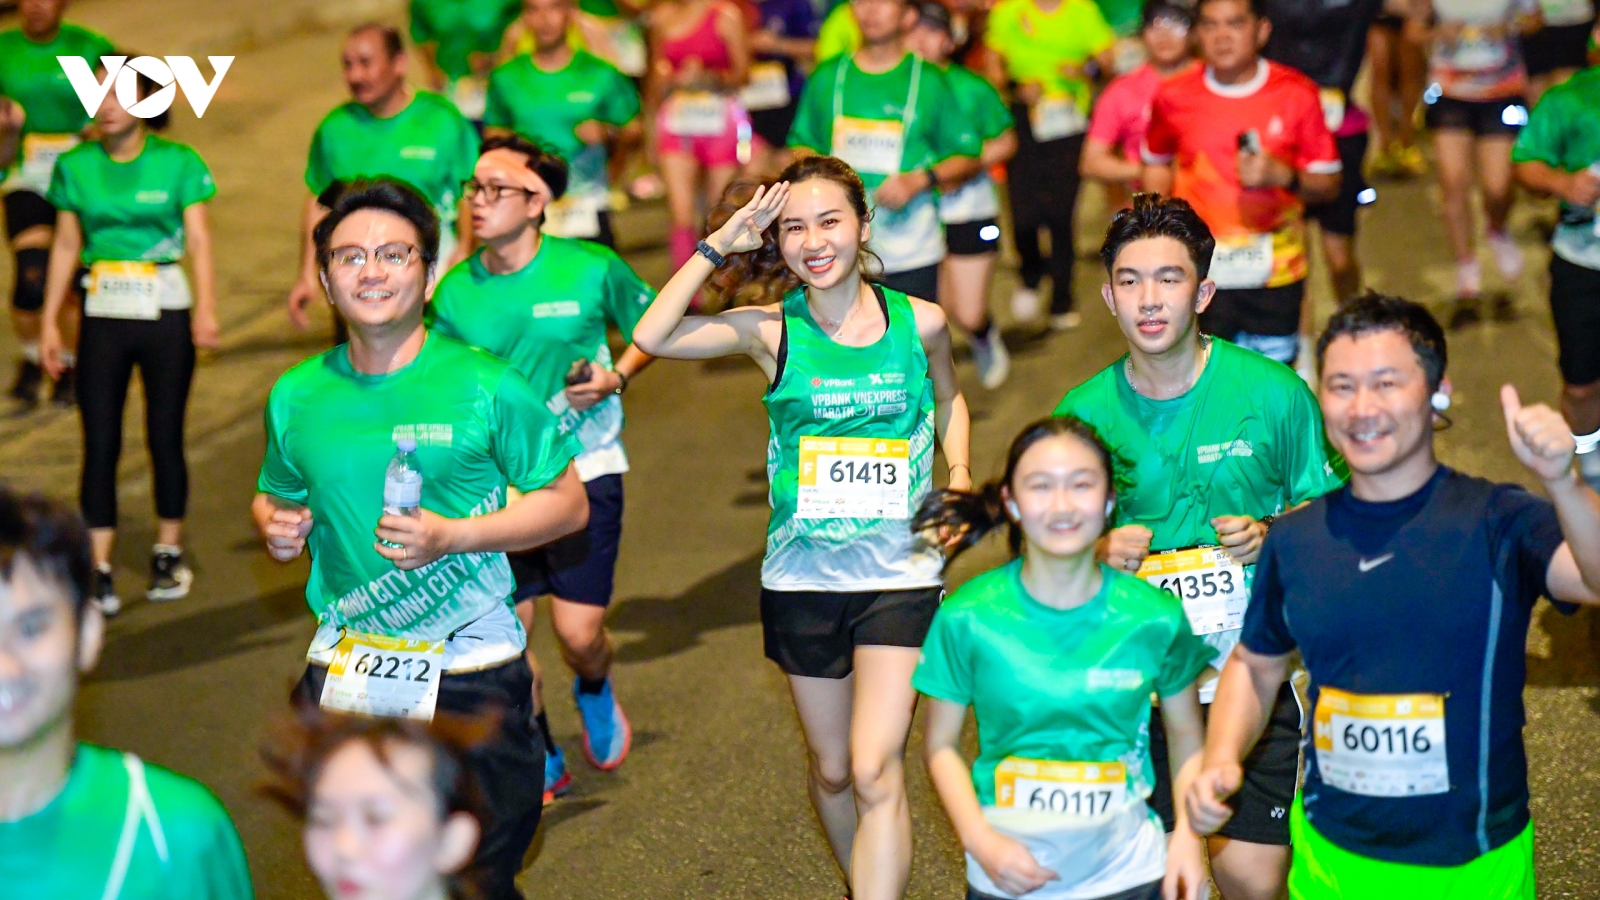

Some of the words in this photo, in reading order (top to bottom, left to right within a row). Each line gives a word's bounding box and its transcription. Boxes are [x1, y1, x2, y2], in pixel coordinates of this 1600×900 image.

[824, 379, 855, 387] VPBank
[811, 393, 852, 407] VPBANK
[853, 389, 907, 404] VNEXPRESS
[803, 462, 813, 477] F
[829, 460, 897, 485] 61413
[338, 585, 377, 620] MINH
[368, 569, 412, 604] CITY
[380, 586, 436, 631] MINH
[427, 553, 469, 598] CITY
[1160, 570, 1235, 600] 61353
[332, 649, 350, 669] M
[354, 653, 431, 683] 62212
[1343, 723, 1432, 754] 60116
[1001, 784, 1012, 803] F
[1029, 787, 1113, 817] 60117
